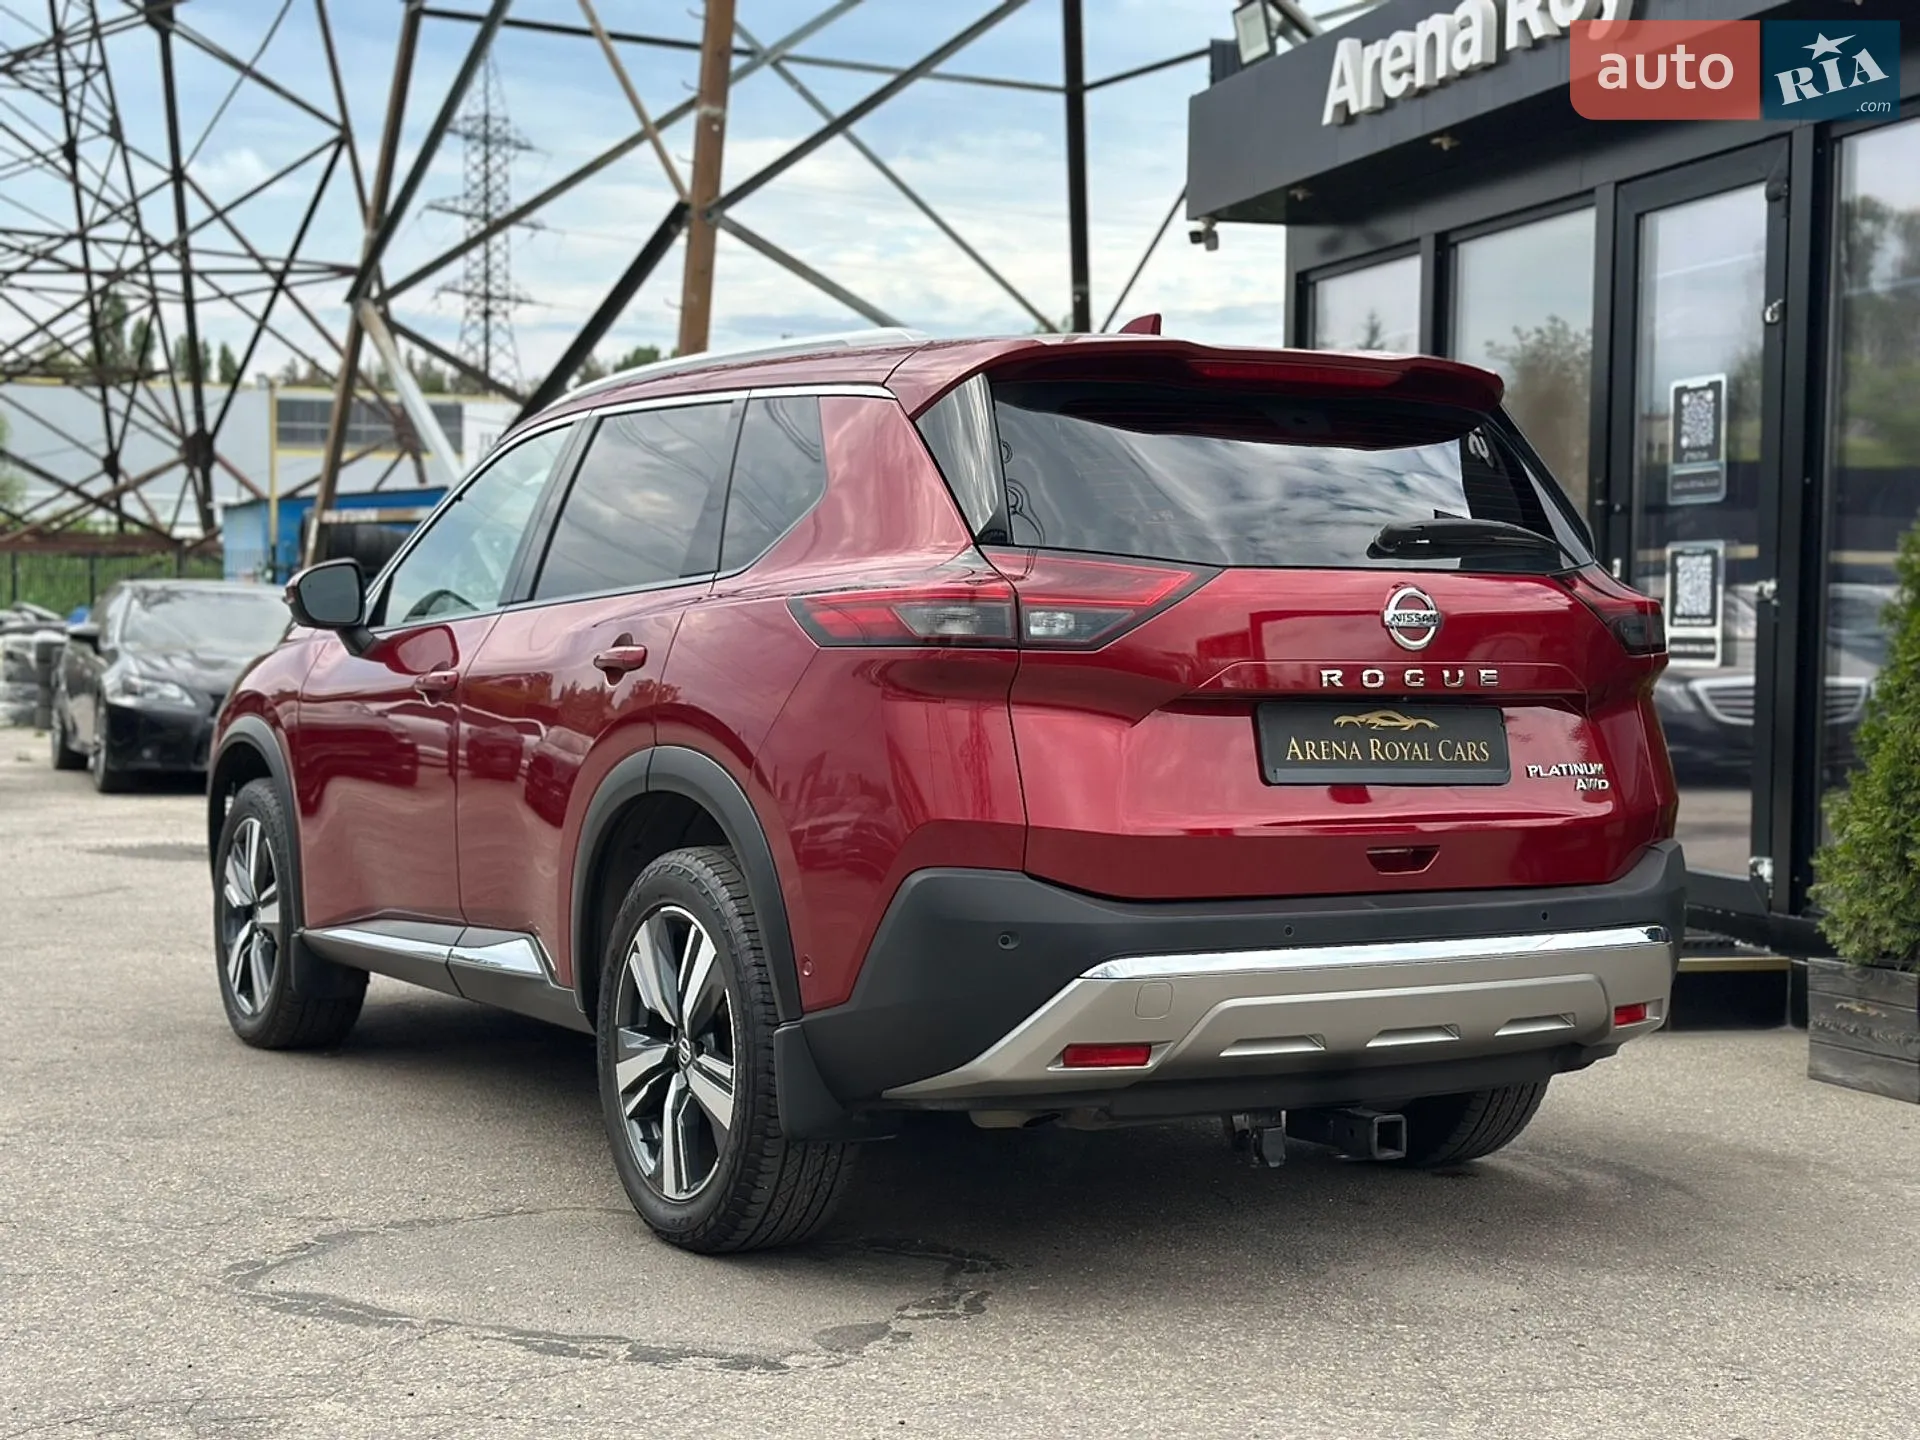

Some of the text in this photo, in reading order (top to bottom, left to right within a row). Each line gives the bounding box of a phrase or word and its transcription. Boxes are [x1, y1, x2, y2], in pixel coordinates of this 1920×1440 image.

[1321, 0, 1498, 126] Arena
[1392, 612, 1439, 623] NISSAN
[1320, 669, 1500, 688] ROGUE
[1526, 763, 1606, 778] PLATINUM
[1575, 778, 1610, 791] AWD
